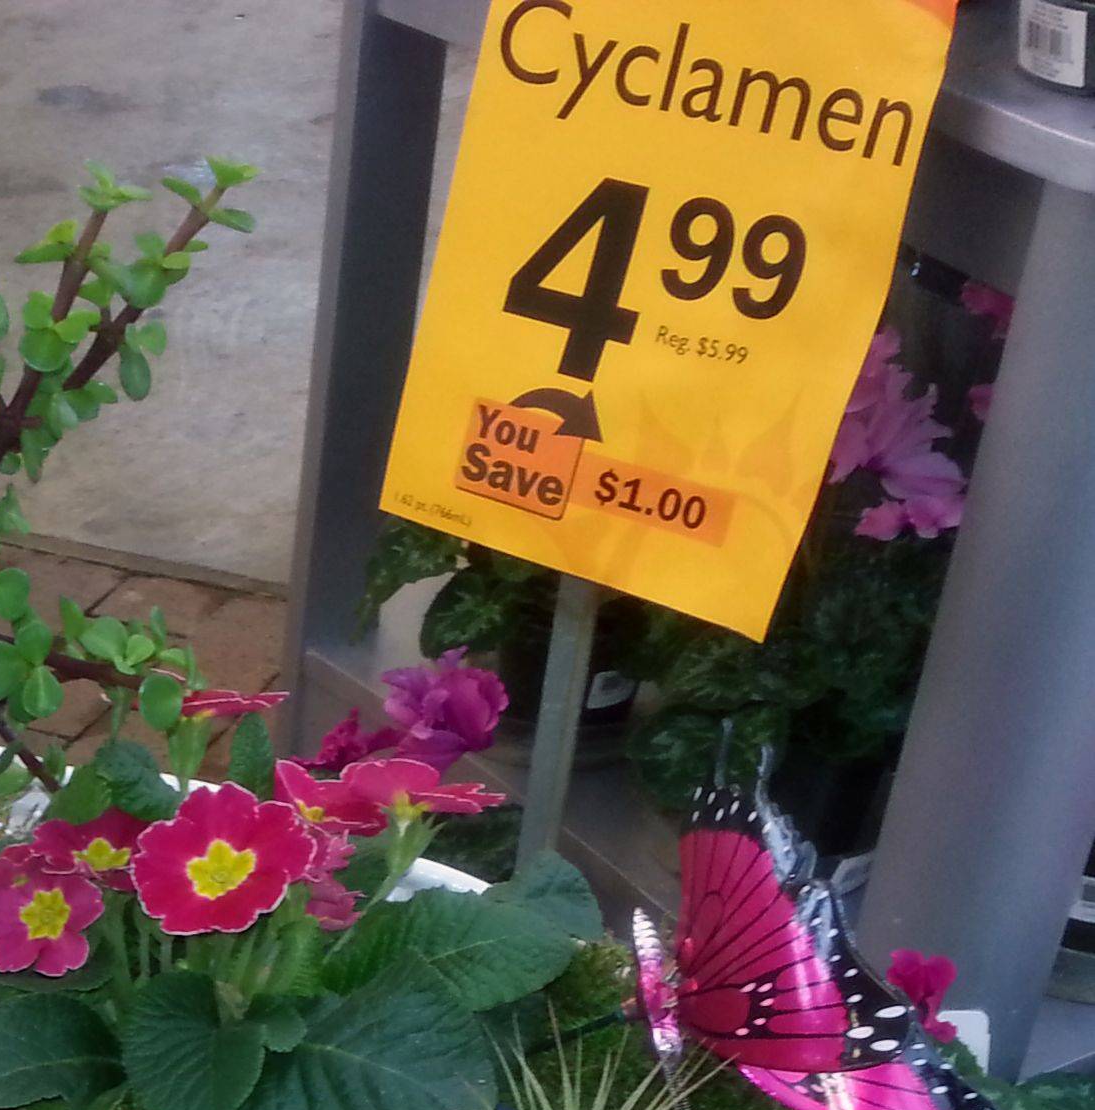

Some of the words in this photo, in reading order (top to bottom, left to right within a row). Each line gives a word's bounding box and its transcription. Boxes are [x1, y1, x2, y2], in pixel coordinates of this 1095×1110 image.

[499, 0, 914, 167] Cyclamen
[655, 325, 690, 355] Reg.
[696, 337, 749, 364] $5.99
[478, 404, 540, 454] You
[461, 443, 564, 506] Save
[594, 468, 706, 529] $1.00
